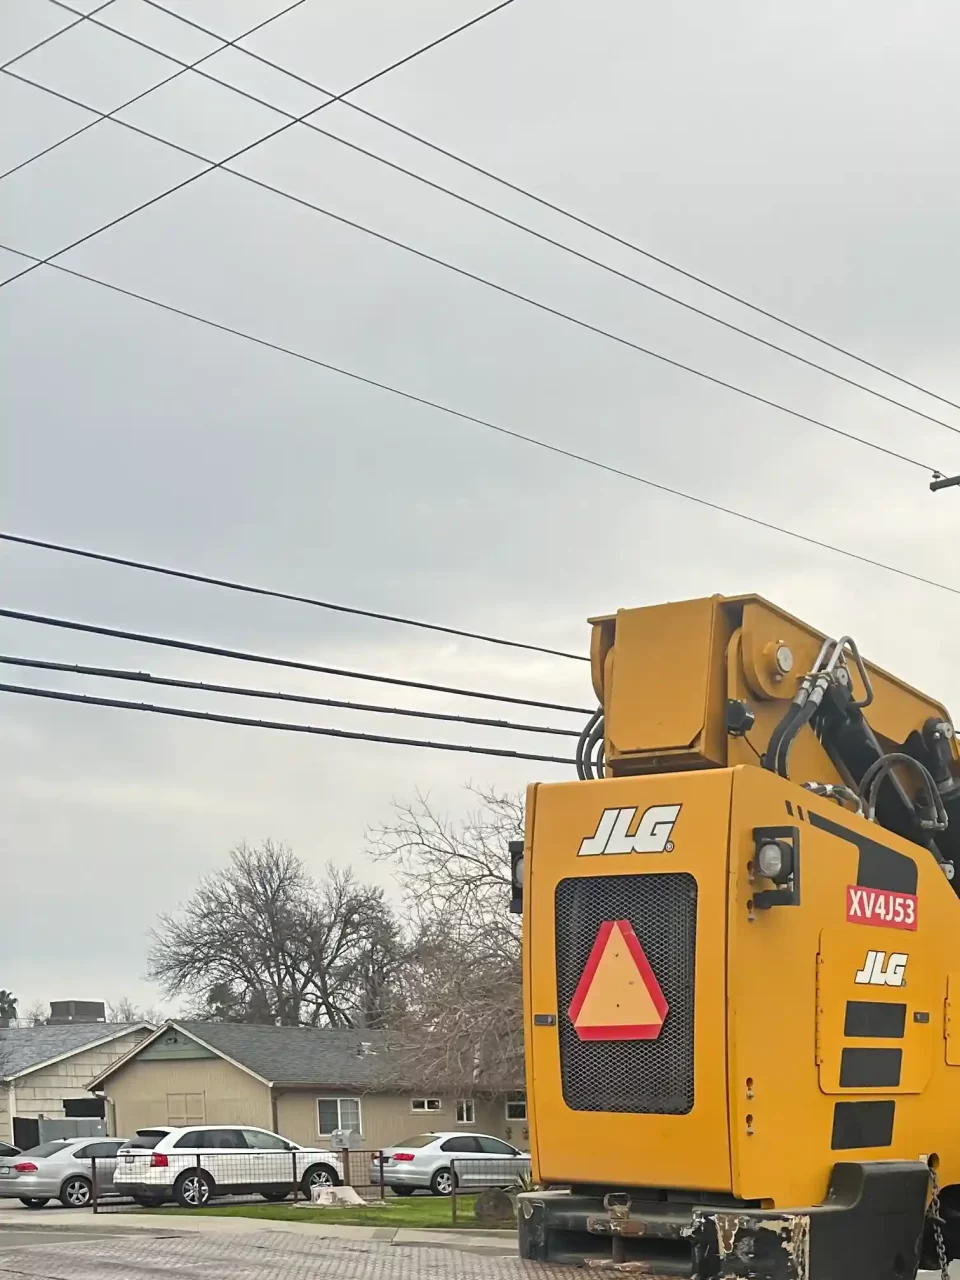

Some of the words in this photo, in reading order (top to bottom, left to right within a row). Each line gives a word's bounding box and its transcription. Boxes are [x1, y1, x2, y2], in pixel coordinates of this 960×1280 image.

[577, 803, 683, 857] JLG
[849, 888, 915, 924] XV4J53
[854, 950, 909, 987] JLG
